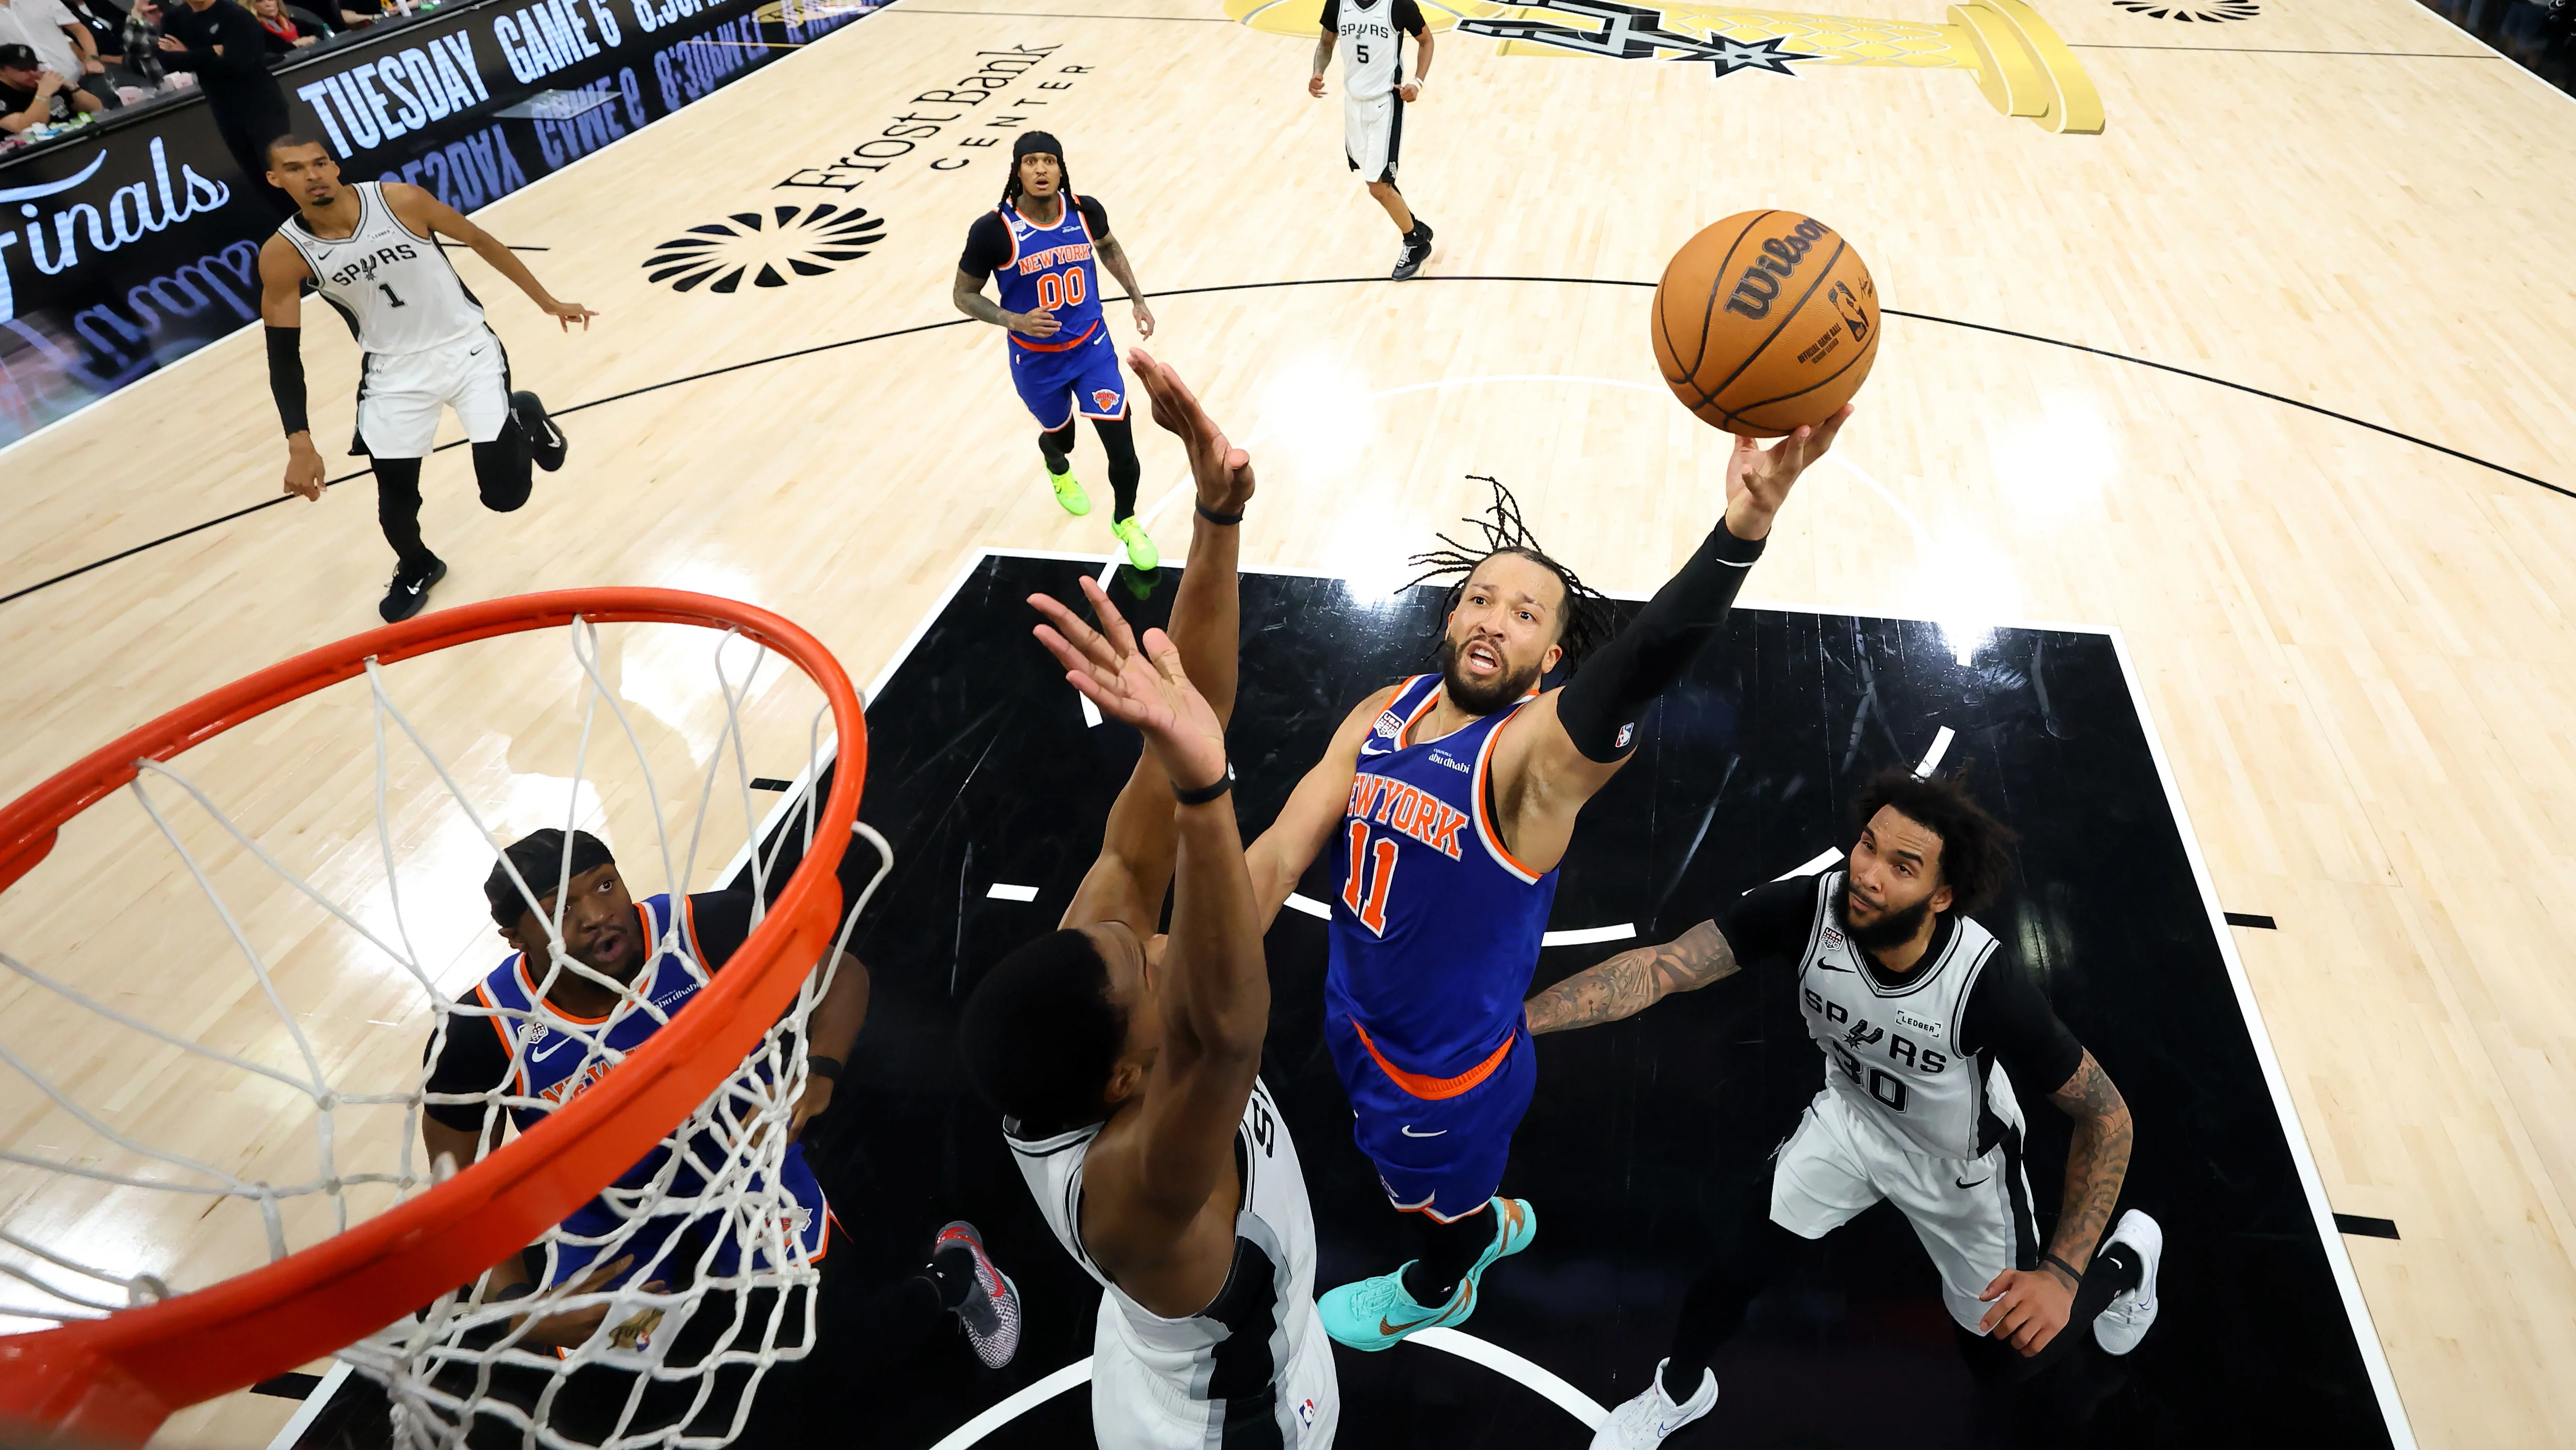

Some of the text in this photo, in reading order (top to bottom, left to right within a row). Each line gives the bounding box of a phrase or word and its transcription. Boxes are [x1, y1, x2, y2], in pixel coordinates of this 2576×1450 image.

[1341, 23, 1389, 40] SPURS
[1357, 44, 1369, 63] 5
[296, 0, 621, 160] TUESDAY GAME 6
[771, 43, 1063, 193] Frost Bank
[931, 64, 1095, 169] CENTER
[332, 243, 417, 286] SPURS
[1018, 243, 1091, 275] NEW YORK
[1723, 217, 1832, 321] Wilson
[378, 281, 407, 309] 1
[1037, 266, 1086, 311] 00
[1428, 753, 1471, 774] abu dhabi
[1375, 776, 1470, 862] YORK
[1342, 818, 1399, 939] 11
[1821, 935, 1840, 949] 250
[1826, 928, 1841, 941] USA
[1805, 987, 1947, 1074] SPURS
[1901, 1015, 1936, 1033] LEDGER
[1832, 1038, 1909, 1115] 30
